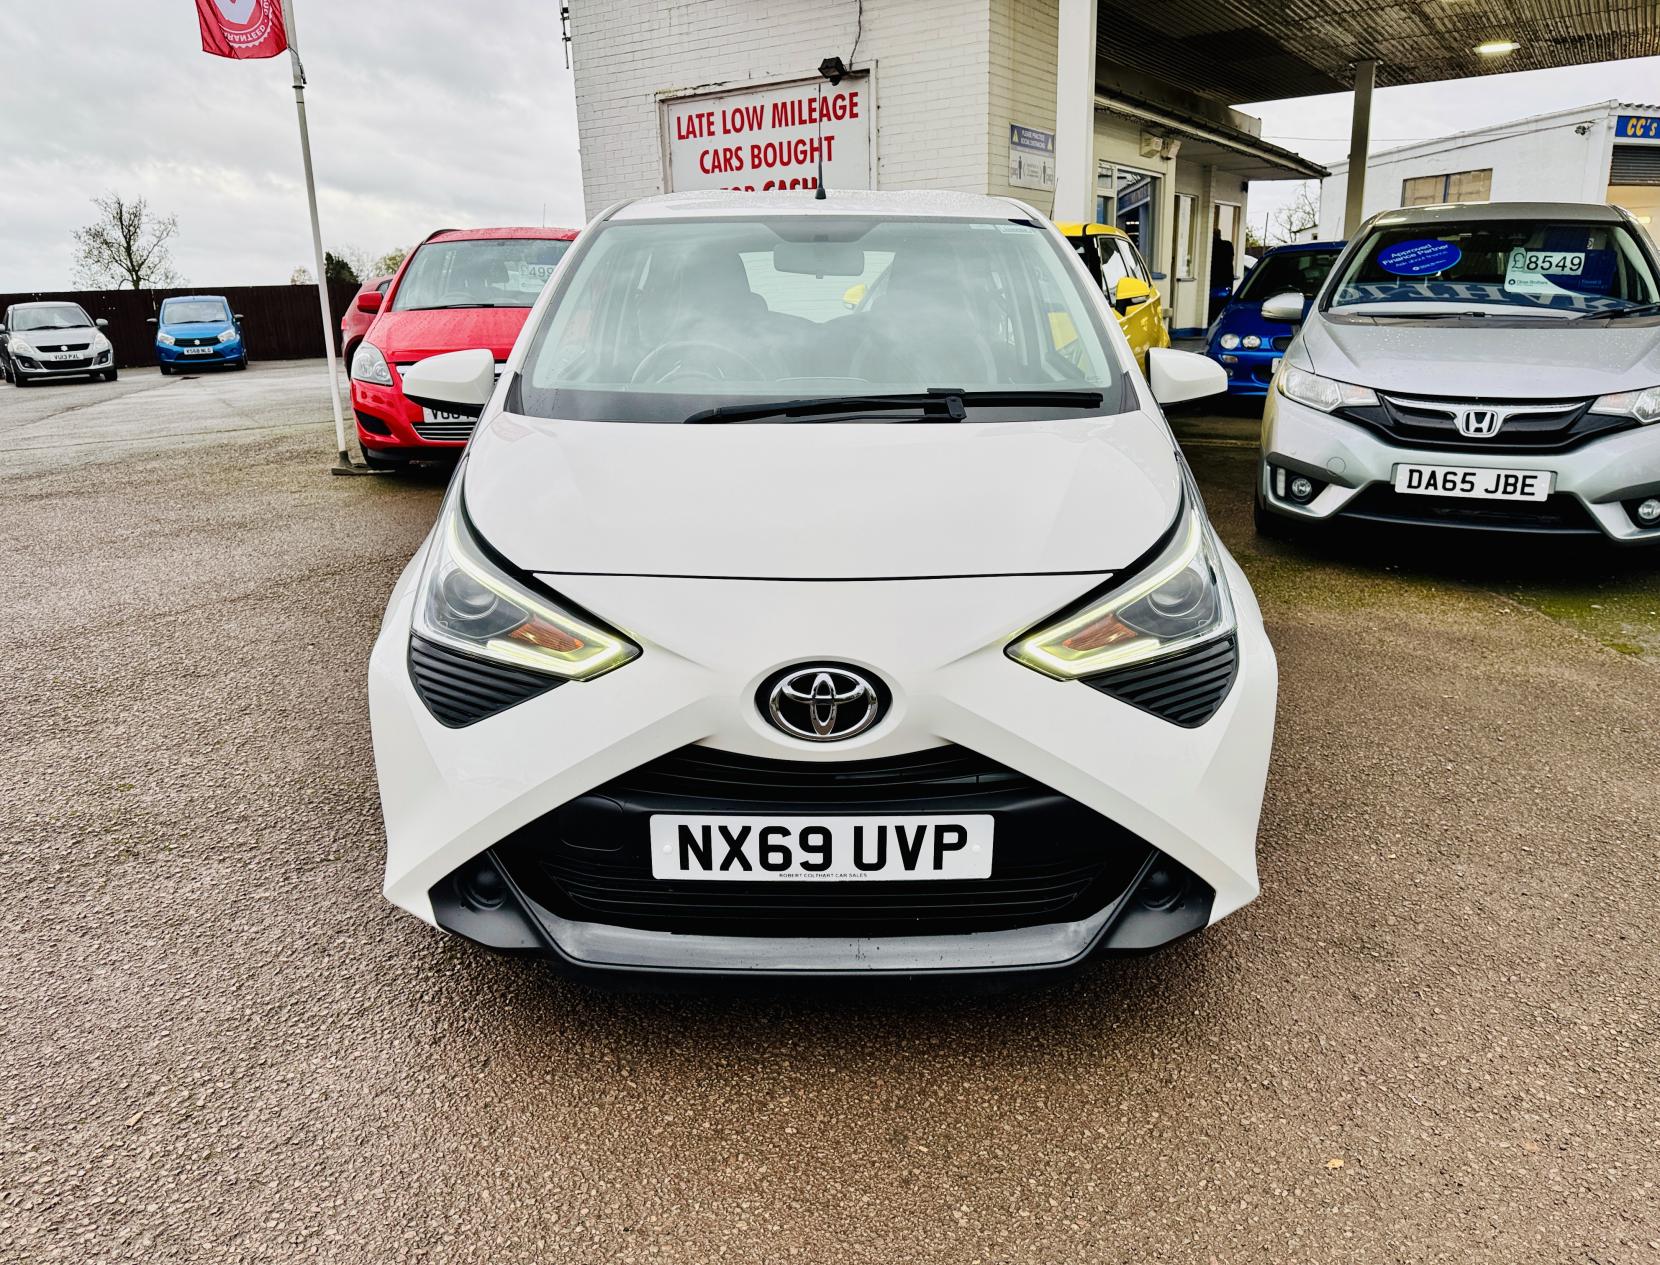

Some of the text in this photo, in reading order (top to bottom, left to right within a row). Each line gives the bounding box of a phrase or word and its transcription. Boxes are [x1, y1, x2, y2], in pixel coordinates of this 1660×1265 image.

[676, 91, 859, 140] LATE LOW MILEAGE
[699, 135, 835, 175] CARS BOUGHT
[1382, 244, 1449, 266] Finance Partner
[1391, 243, 1433, 258] Approved
[1511, 252, 1583, 272] £8549
[1406, 468, 1538, 497] DA65 JBE
[677, 823, 968, 872] NX69 UVP
